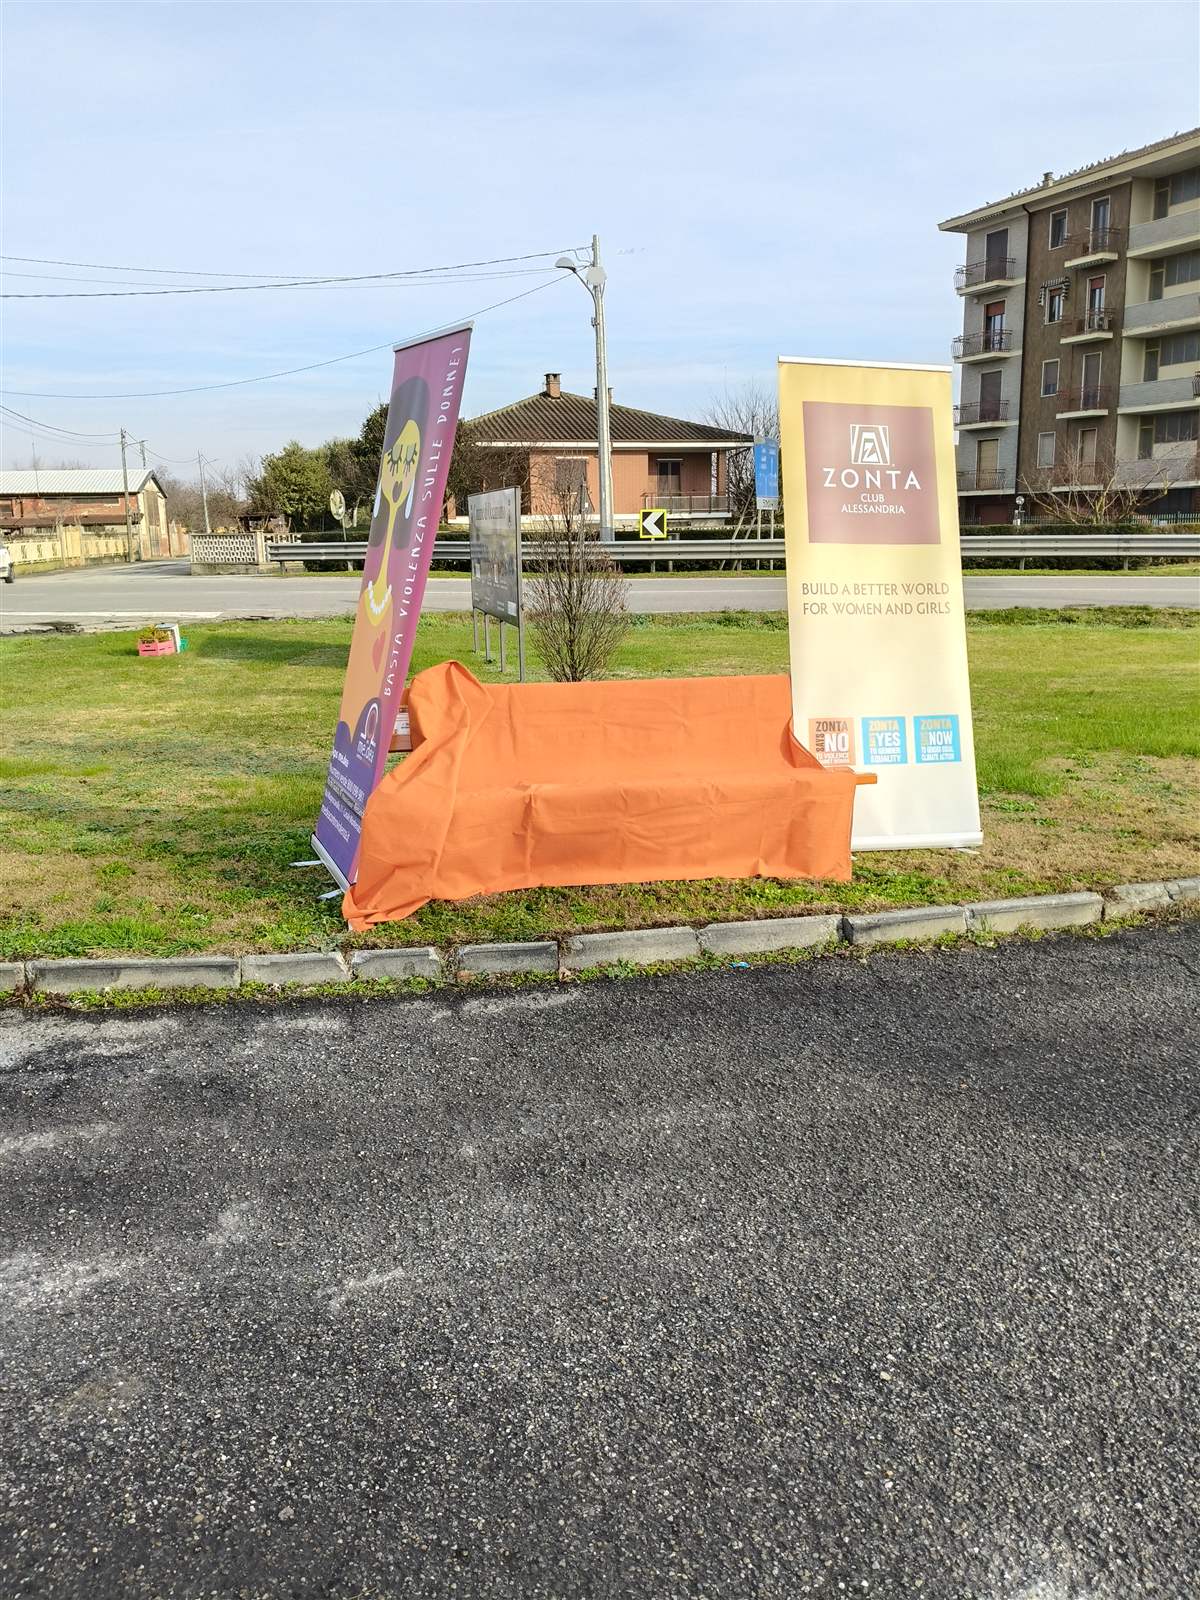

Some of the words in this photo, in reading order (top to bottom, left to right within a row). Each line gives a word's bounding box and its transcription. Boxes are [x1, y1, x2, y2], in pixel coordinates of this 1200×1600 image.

[822, 468, 921, 490] ZONTA
[860, 493, 885, 503] CLUB
[841, 504, 906, 514] ALESSANDRIA
[384, 633, 403, 696] BASTA
[399, 516, 427, 617] VIOLENZA
[421, 439, 443, 502] SULLE
[802, 583, 838, 595] BUILD
[842, 583, 850, 596] A
[853, 583, 899, 596] BETTER
[901, 582, 949, 595] WORLD
[803, 603, 828, 615] FOR
[832, 603, 882, 615] WOMEN
[885, 603, 913, 615] AND
[916, 602, 951, 614] GIRLS
[815, 721, 849, 732] ZONTA
[868, 720, 899, 731] ZONTA
[919, 718, 952, 731] ZONTA
[815, 733, 825, 752] SAYS
[824, 732, 850, 753] NO
[875, 731, 901, 747] YES
[928, 730, 953, 746] NOW
[870, 755, 901, 763] EQUALITY
